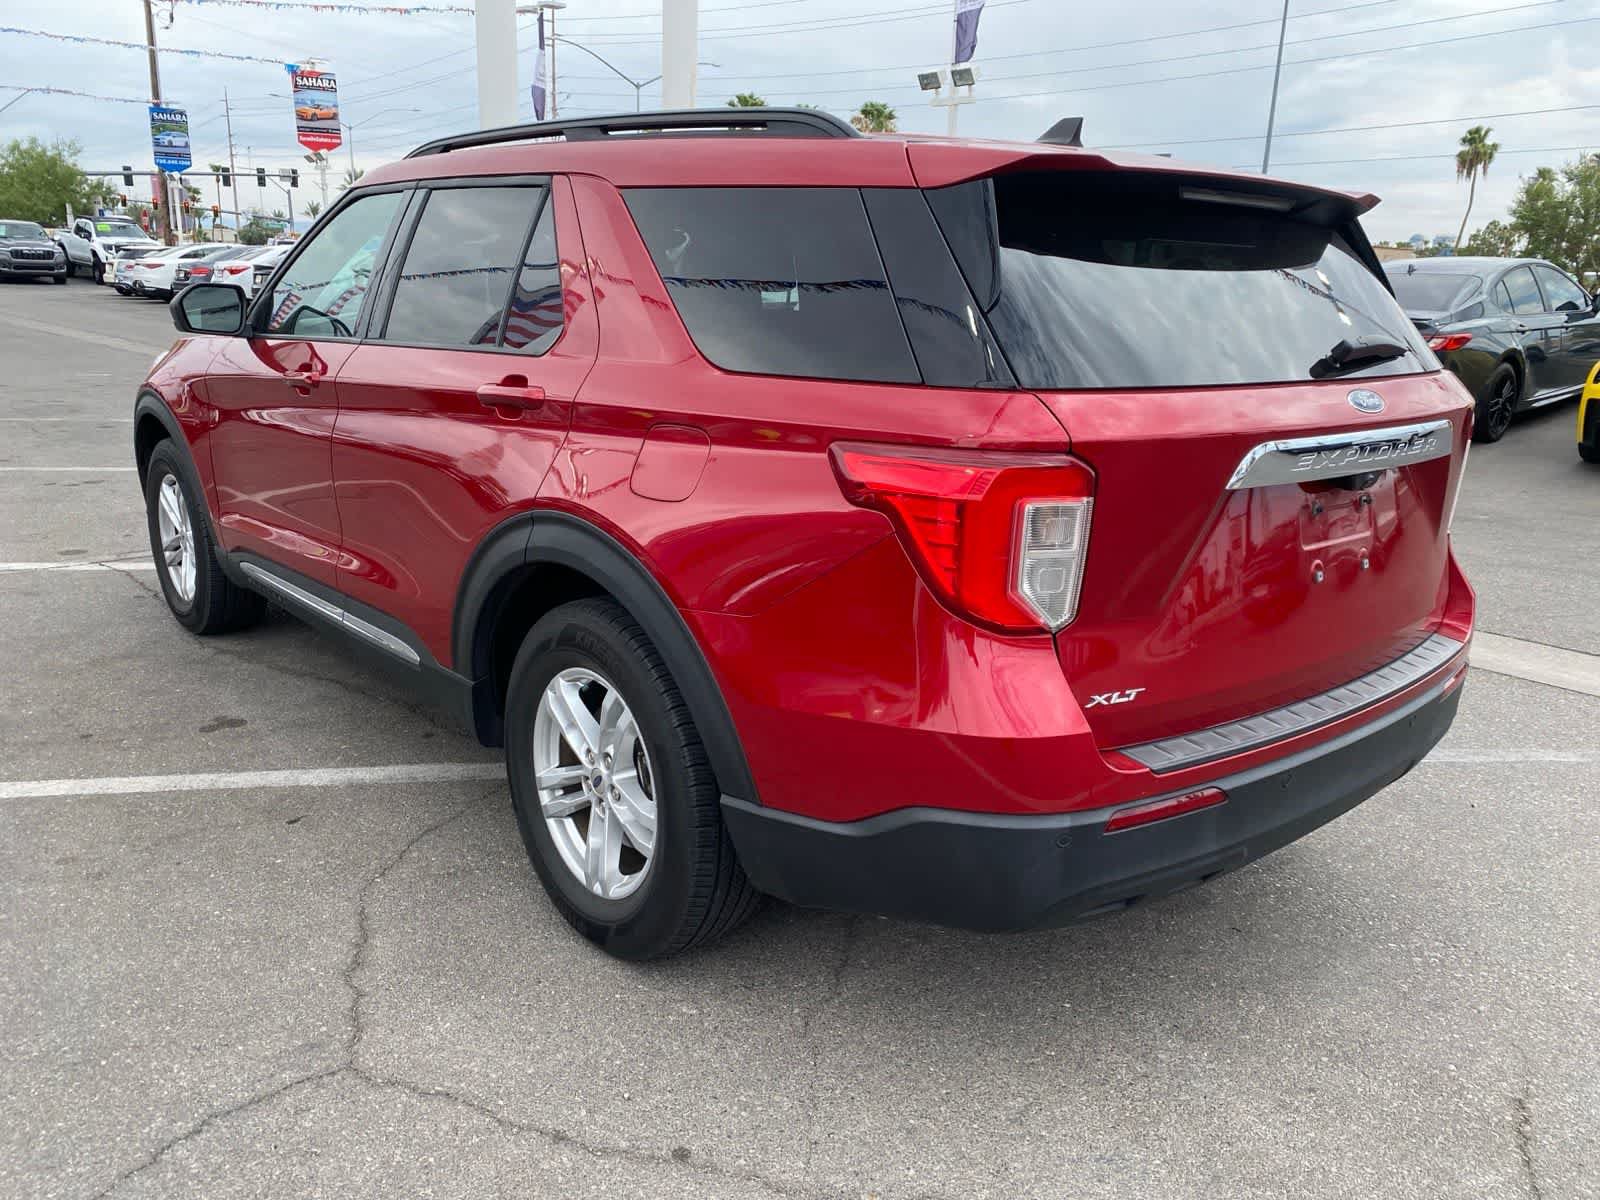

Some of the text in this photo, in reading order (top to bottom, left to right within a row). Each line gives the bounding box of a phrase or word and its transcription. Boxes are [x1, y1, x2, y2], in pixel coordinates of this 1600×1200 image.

[296, 76, 336, 89] SAHARA
[152, 112, 187, 122] SAHARA
[1291, 436, 1439, 472] EXPLORER
[1084, 687, 1146, 708] XLT
